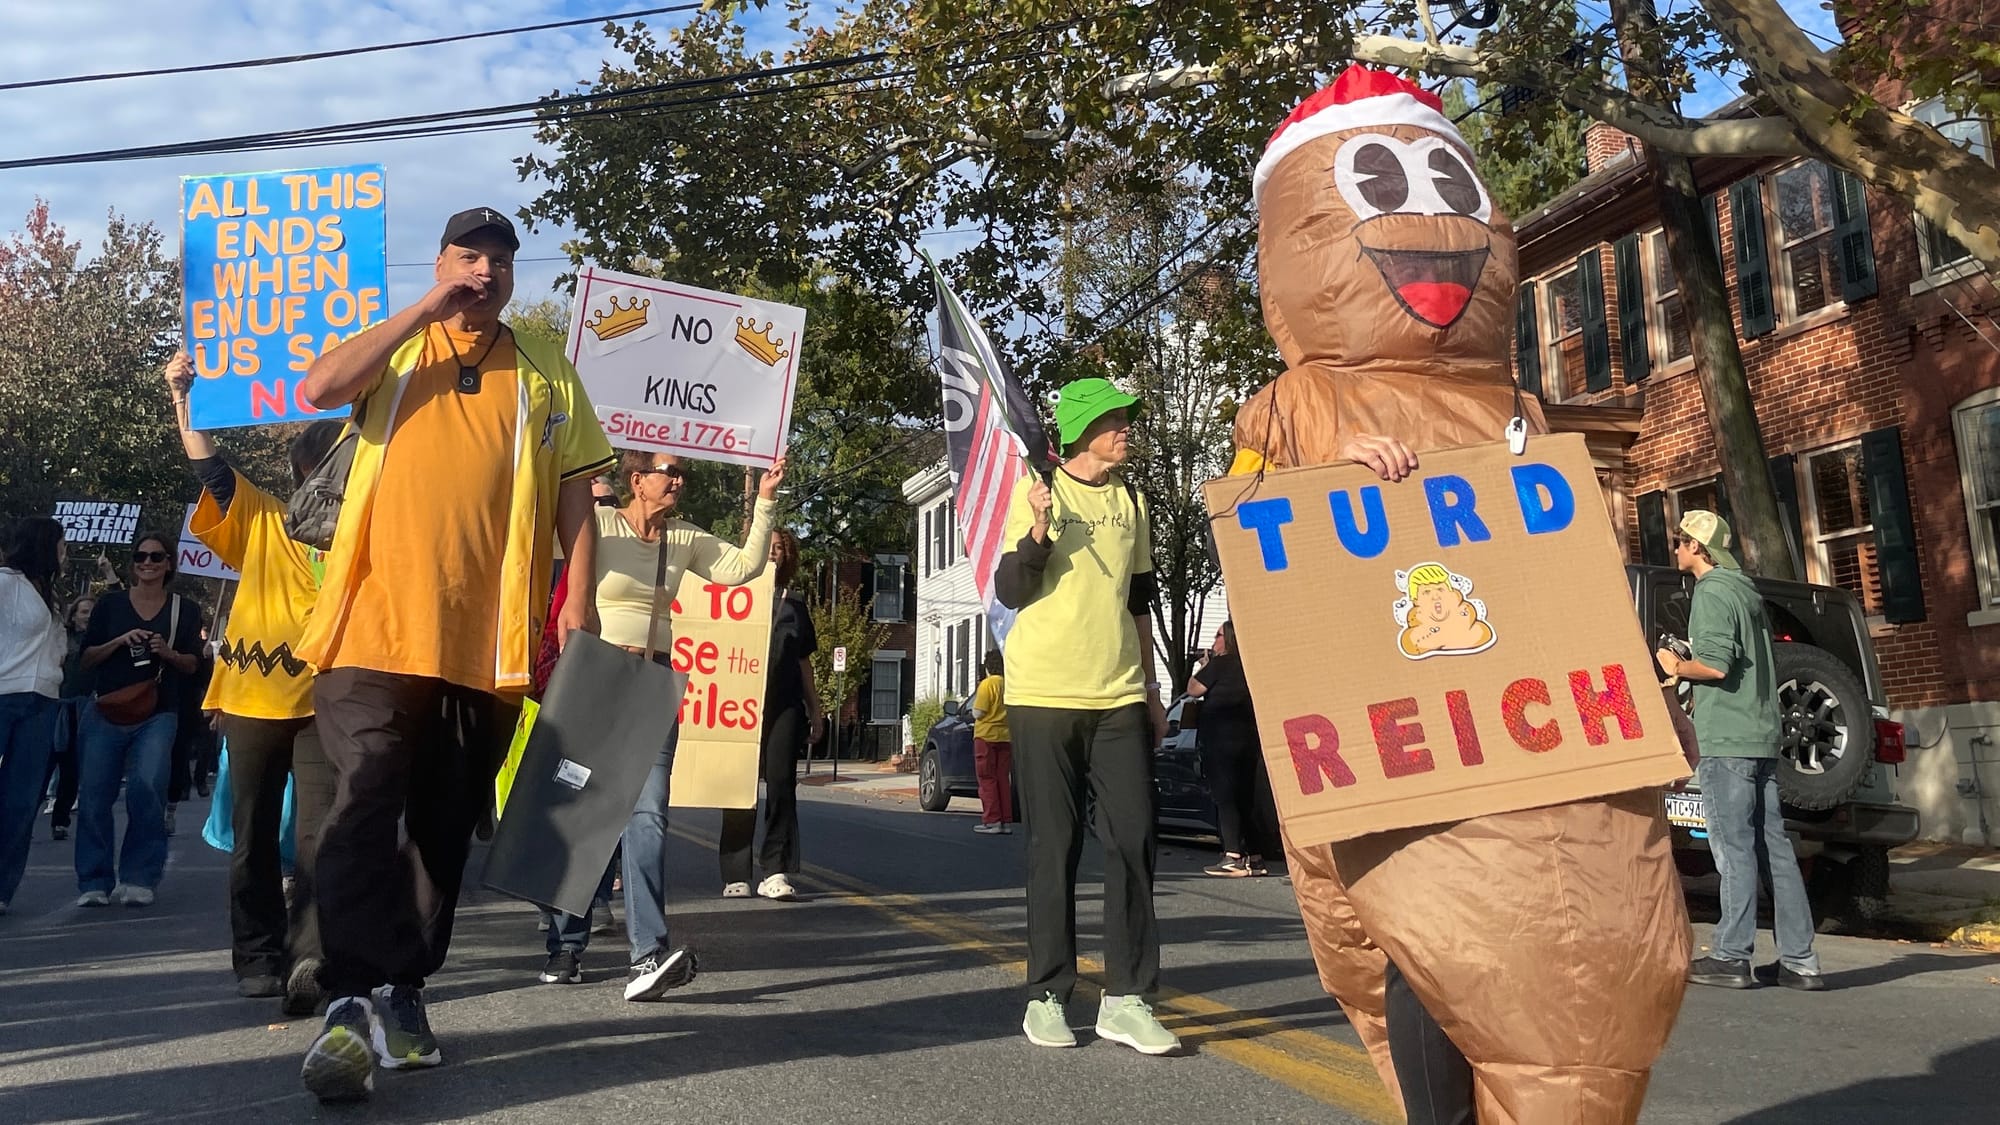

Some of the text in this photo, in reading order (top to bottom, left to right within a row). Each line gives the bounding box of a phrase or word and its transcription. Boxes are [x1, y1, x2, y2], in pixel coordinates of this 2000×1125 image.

[187, 172, 383, 220] ALL THIS
[216, 214, 345, 259] ENDS
[213, 252, 349, 299] WHEN
[192, 287, 381, 339] ENUF OF
[671, 313, 713, 344] NO
[195, 337, 261, 379] US
[644, 375, 718, 414] KINGS
[55, 501, 141, 518] TRUMP'S AN
[1237, 462, 1576, 572] TURD
[180, 549, 212, 568] NO
[703, 583, 753, 621] TO
[728, 647, 760, 675] the
[1282, 663, 1645, 796] REICH
